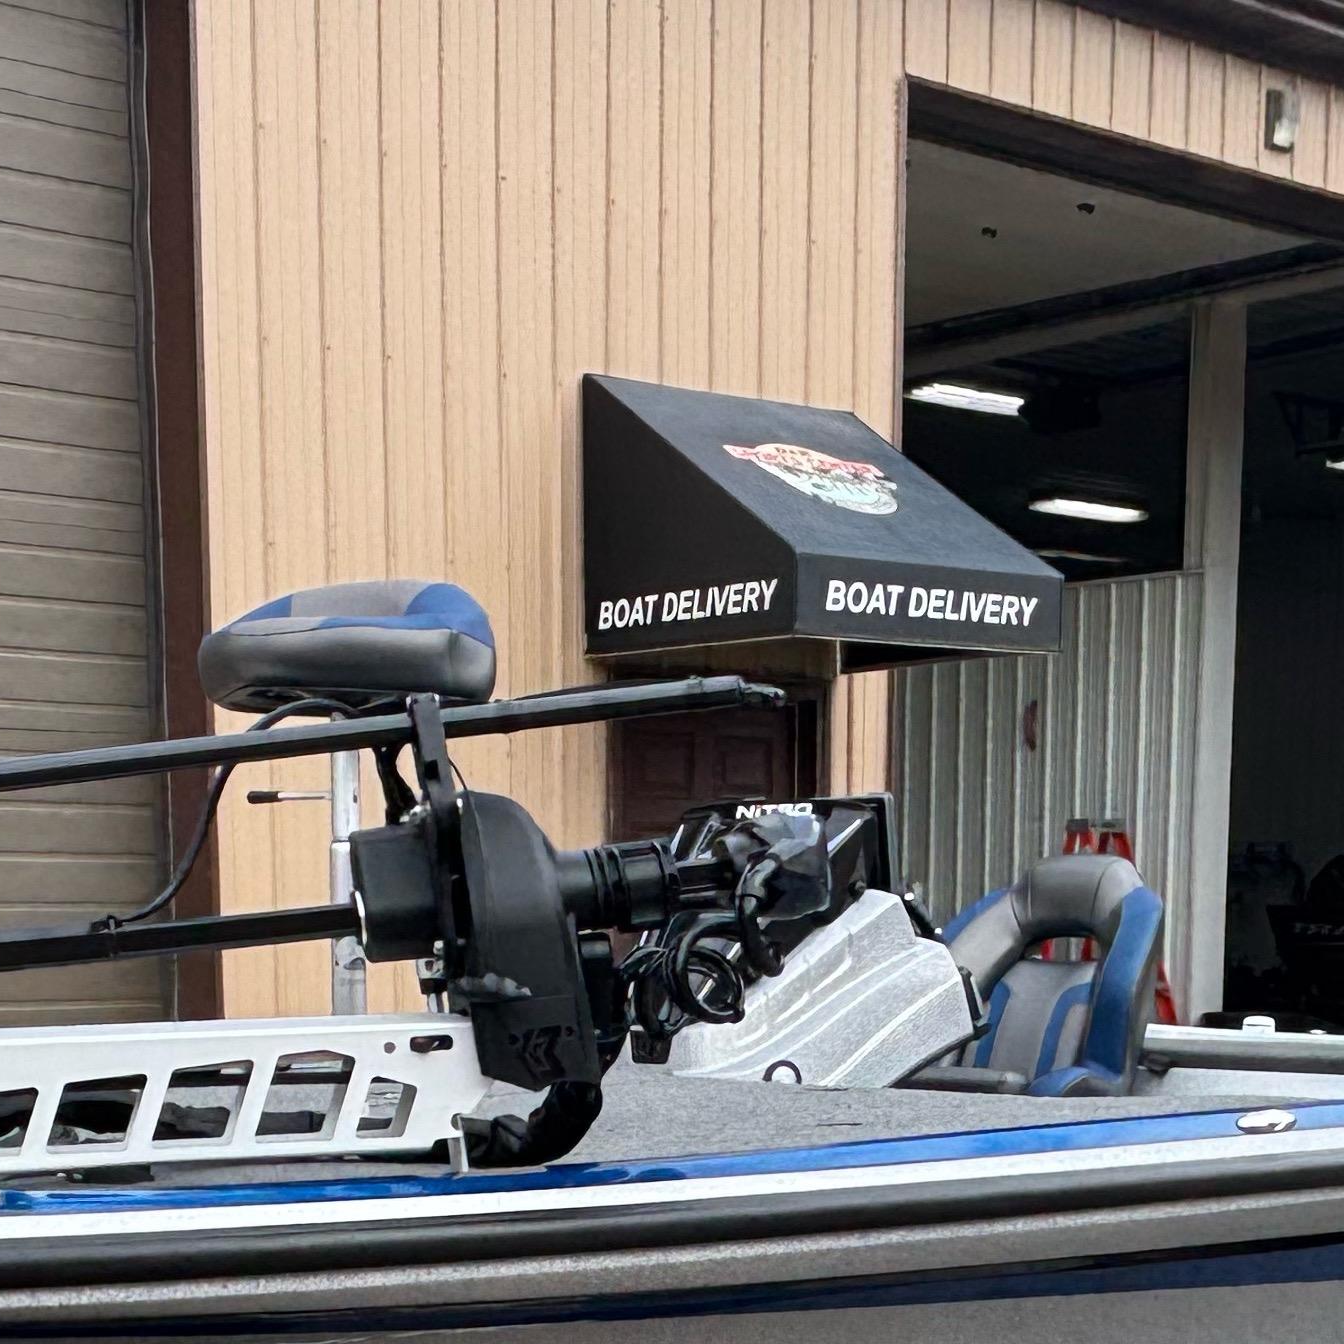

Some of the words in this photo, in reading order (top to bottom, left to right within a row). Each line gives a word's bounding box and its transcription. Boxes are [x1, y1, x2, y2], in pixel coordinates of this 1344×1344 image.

[598, 593, 659, 631] BOAT
[661, 578, 778, 623] DELIVERY
[825, 579, 904, 617] BOAT
[907, 584, 1038, 627] DELIVERY
[735, 802, 814, 820] NITRO
